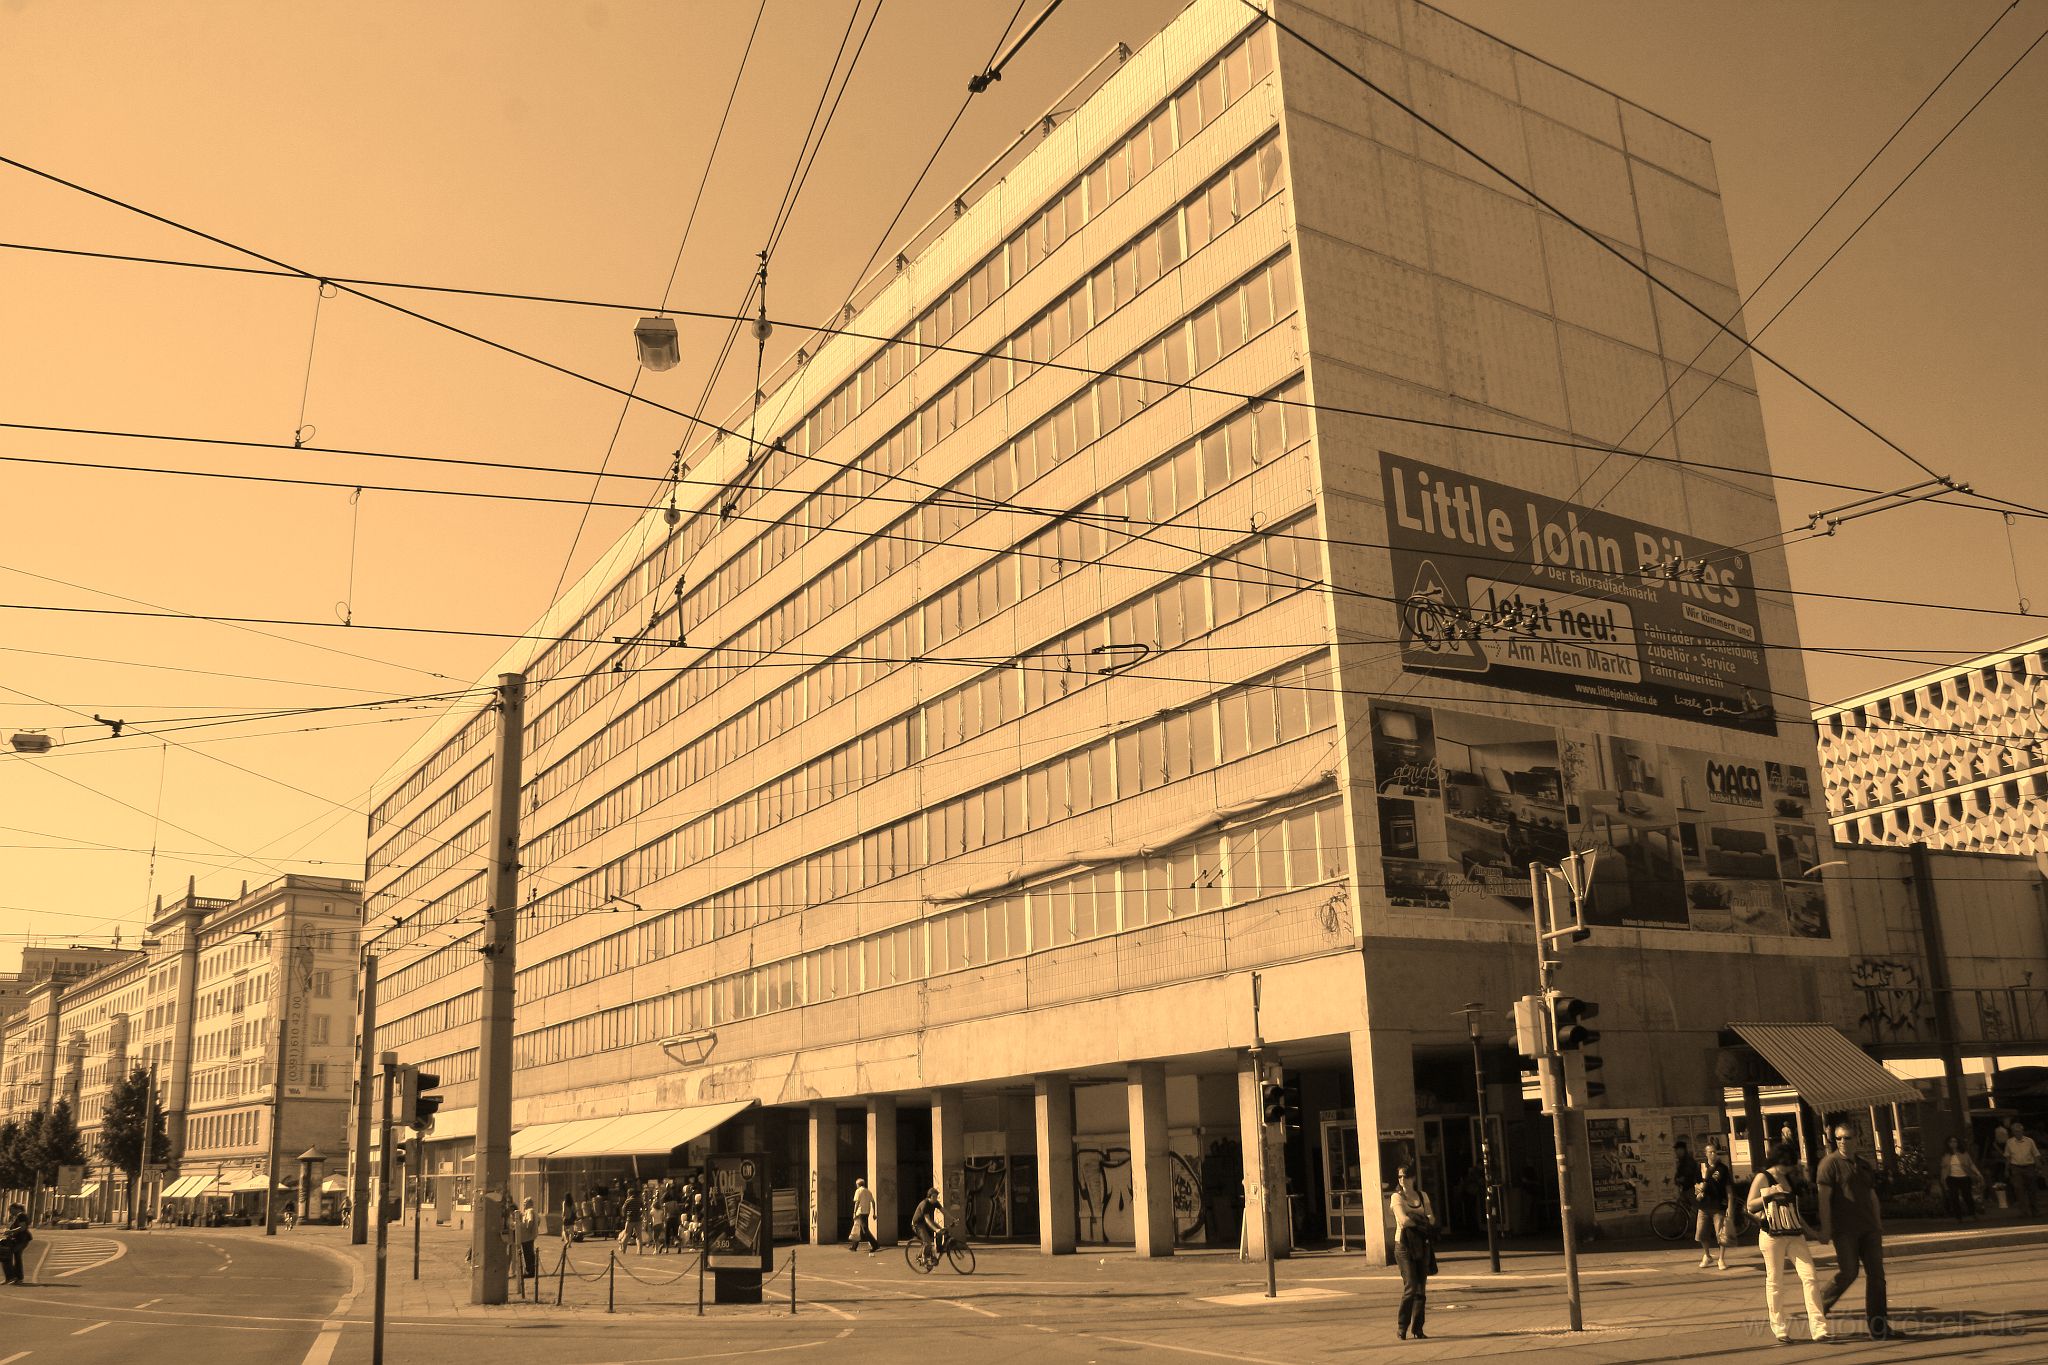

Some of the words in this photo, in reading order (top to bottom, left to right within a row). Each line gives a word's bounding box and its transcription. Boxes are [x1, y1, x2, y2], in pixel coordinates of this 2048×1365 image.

[1392, 467, 1514, 553] Little
[1526, 502, 1624, 577] John
[1548, 567, 1566, 582] Der
[1570, 570, 1658, 603] Fahrradfachmarkt
[1487, 586, 1552, 633] Jetzt
[1559, 608, 1617, 642] neu!
[1685, 606, 1699, 619] Wir
[1701, 610, 1736, 632] kümmern
[1737, 626, 1752, 639] uns!
[1508, 636, 1536, 662] Am
[1540, 641, 1582, 668] Alten
[1586, 649, 1633, 676] Markt
[1643, 622, 1694, 646] Fahrräder
[1705, 638, 1759, 665] Bekleidung
[1646, 641, 1691, 664] Zubehör
[1700, 653, 1737, 673] Service
[1649, 660, 1724, 689] Fahrradverleih
[1574, 683, 1658, 707] www.littlejohnbikes.de
[1674, 694, 1702, 709] Little
[1706, 759, 1762, 800] MACO
[1710, 791, 1732, 803] Möbel
[1739, 796, 1763, 808] Küchen
[292, 996, 302, 1009] 00
[292, 1012, 301, 1025] 42
[290, 1028, 300, 1047] 610
[288, 1049, 298, 1082] (0391)
